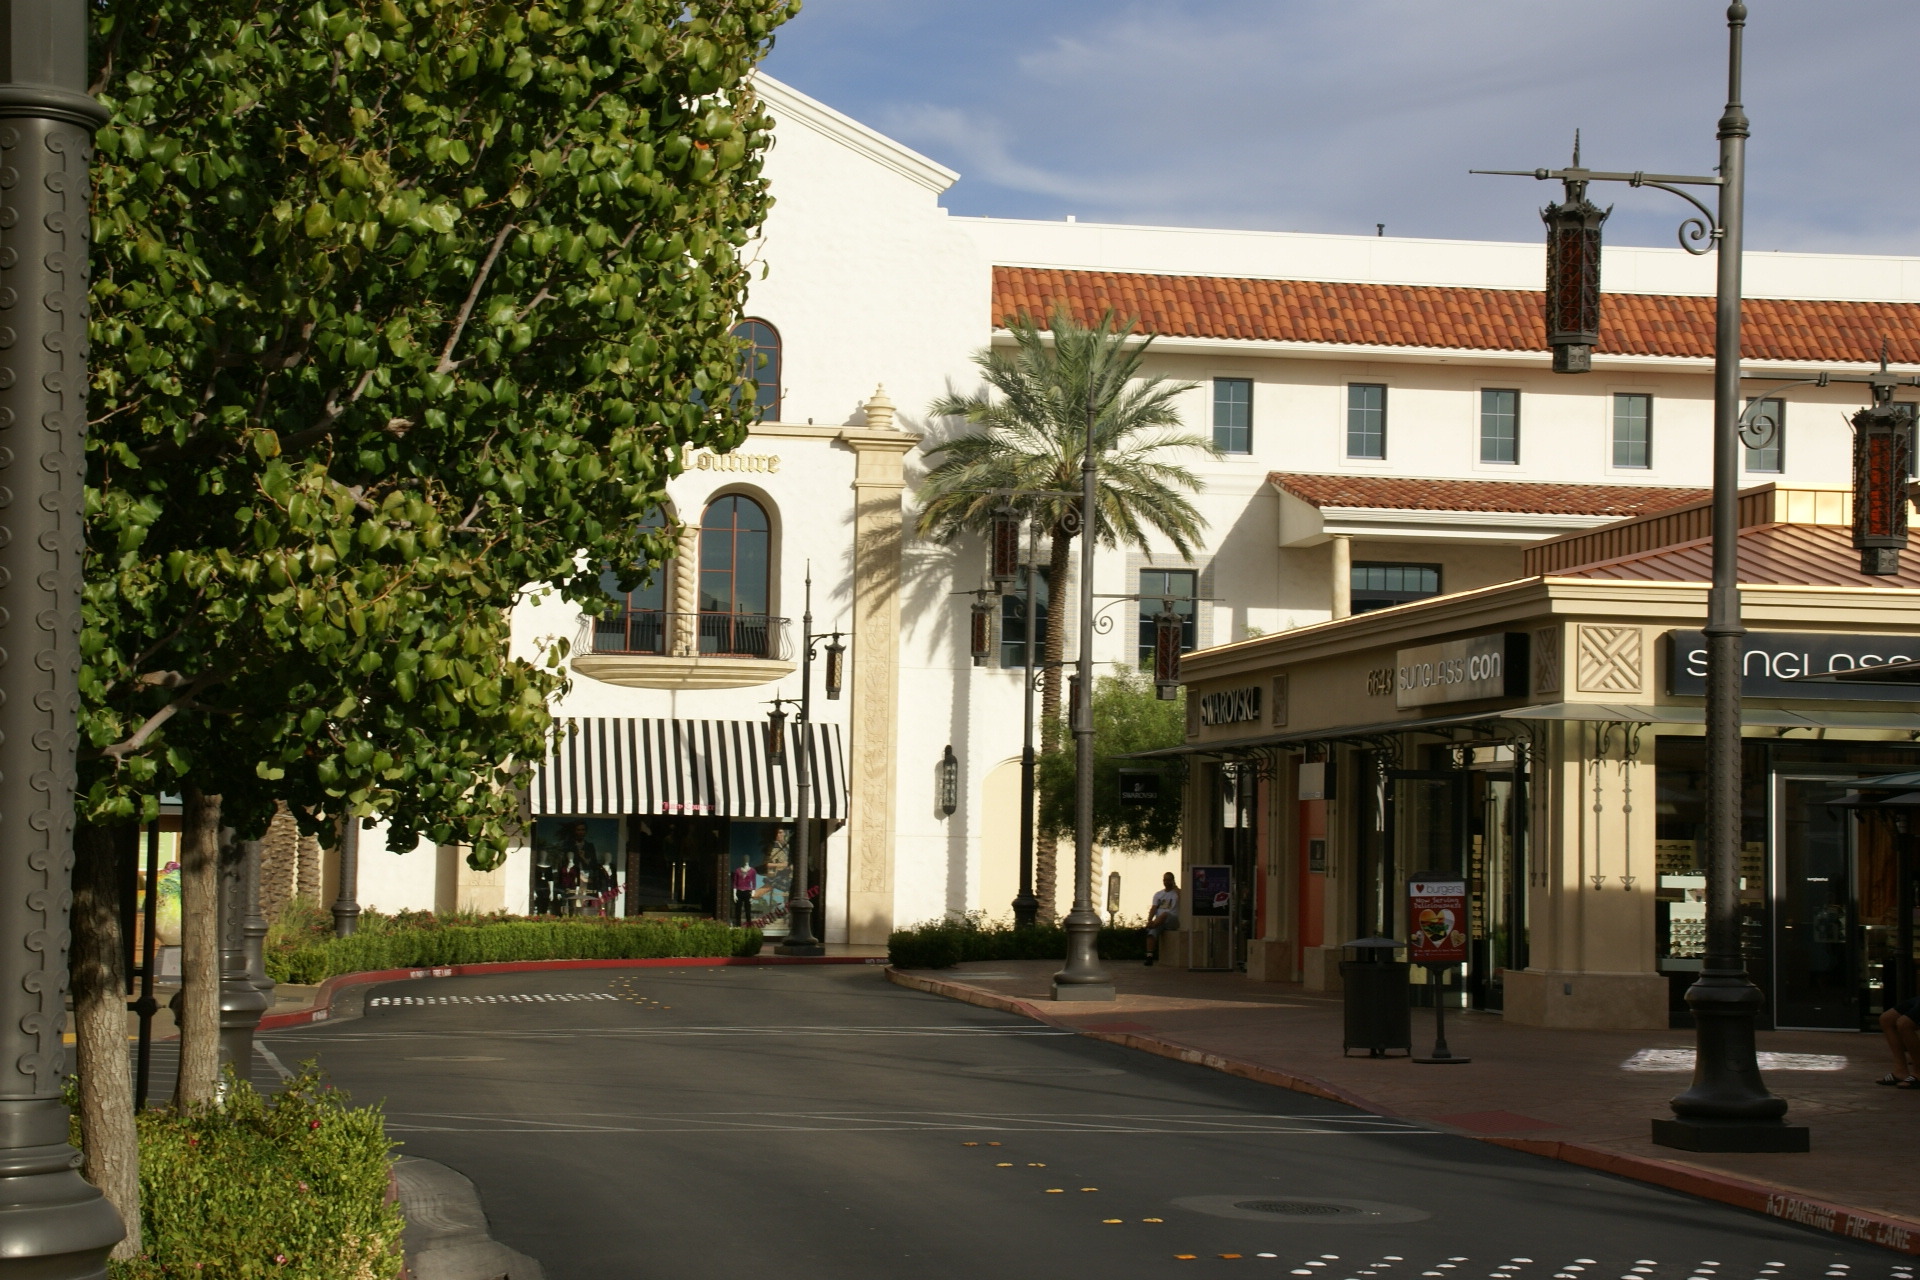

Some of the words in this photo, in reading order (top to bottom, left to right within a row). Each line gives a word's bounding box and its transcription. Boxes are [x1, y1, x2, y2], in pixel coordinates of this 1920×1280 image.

[1686, 649, 1911, 678] SNGLAS
[1366, 668, 1394, 696] 6643
[1200, 686, 1255, 727] SWAROVSKI
[1426, 884, 1461, 895] burgers
[1786, 1199, 1836, 1231] PARKING
[1845, 1215, 1873, 1240] FIRE
[1876, 1223, 1910, 1249] LANE
